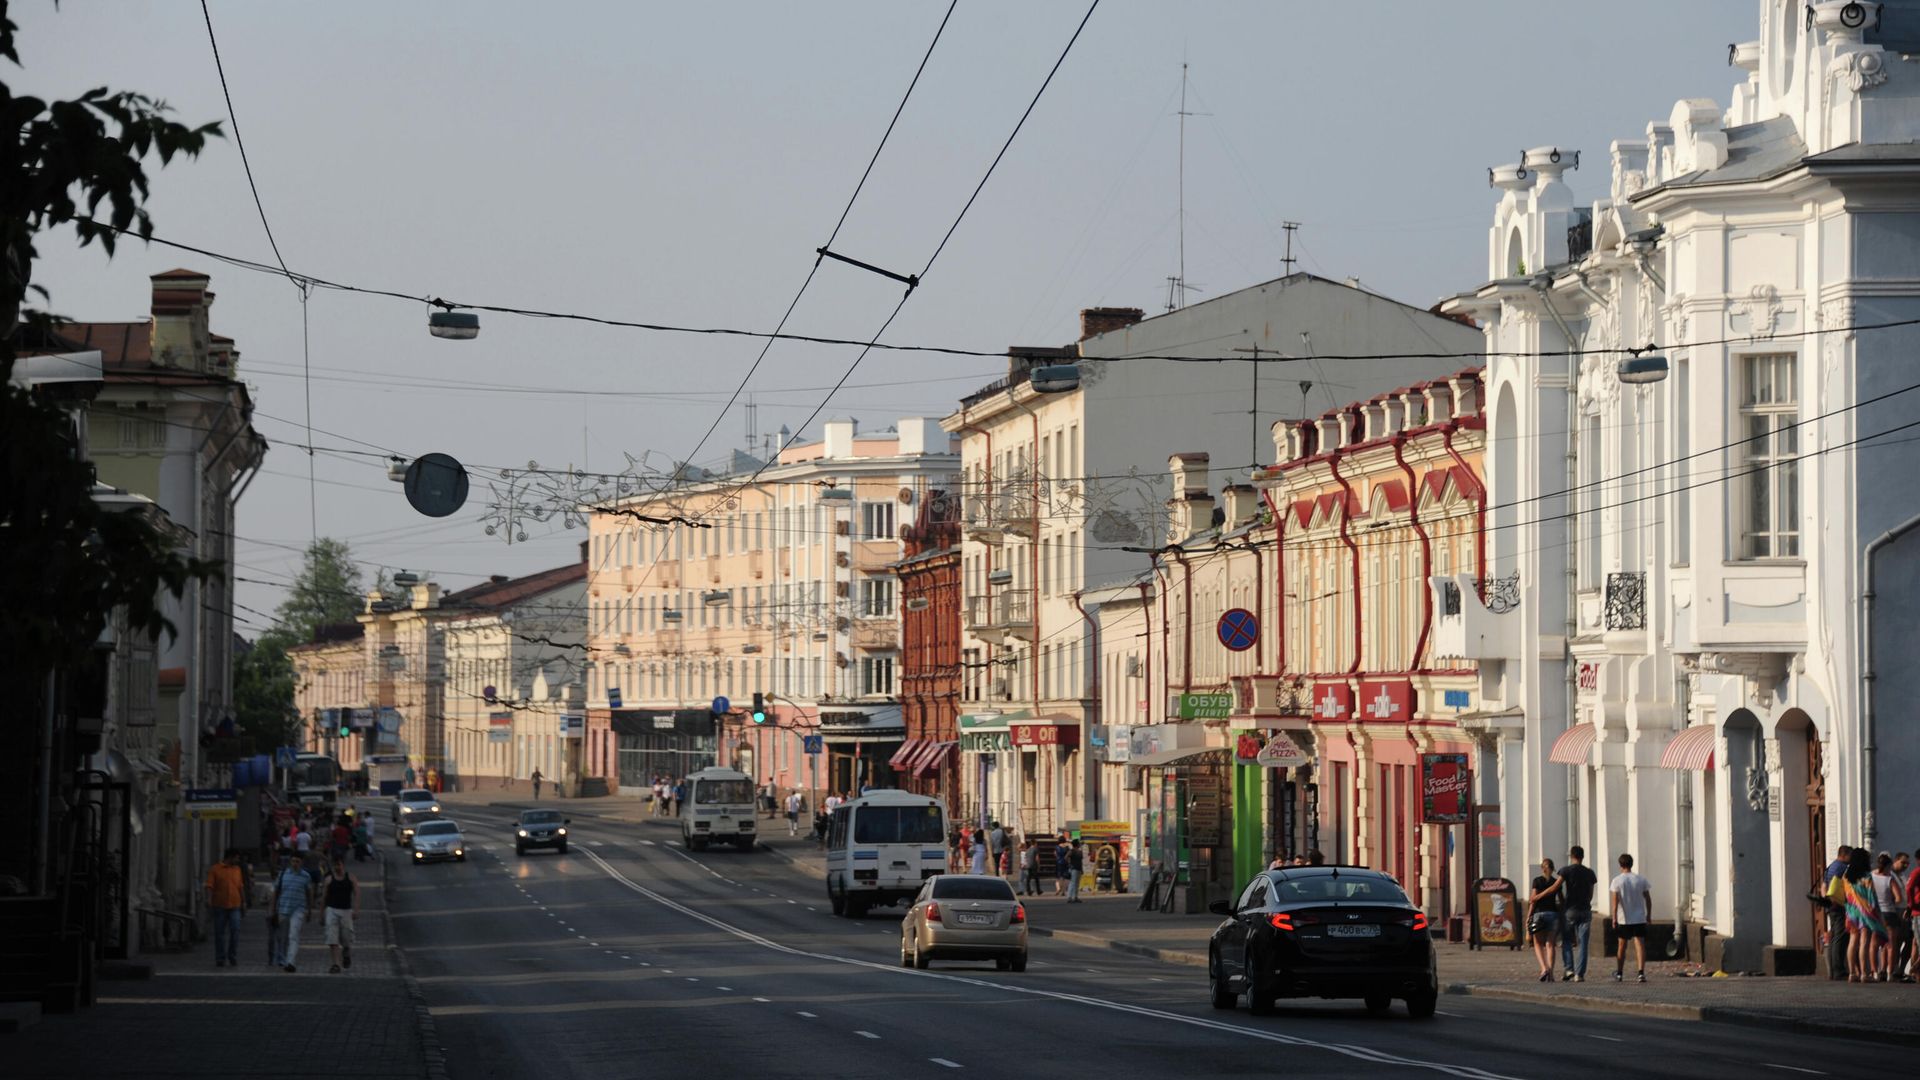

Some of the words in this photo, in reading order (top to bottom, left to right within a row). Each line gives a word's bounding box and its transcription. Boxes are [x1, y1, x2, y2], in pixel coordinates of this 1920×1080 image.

[1270, 748, 1297, 758] PIZZA
[1428, 774, 1456, 788] Food
[1424, 782, 1468, 796] Master
